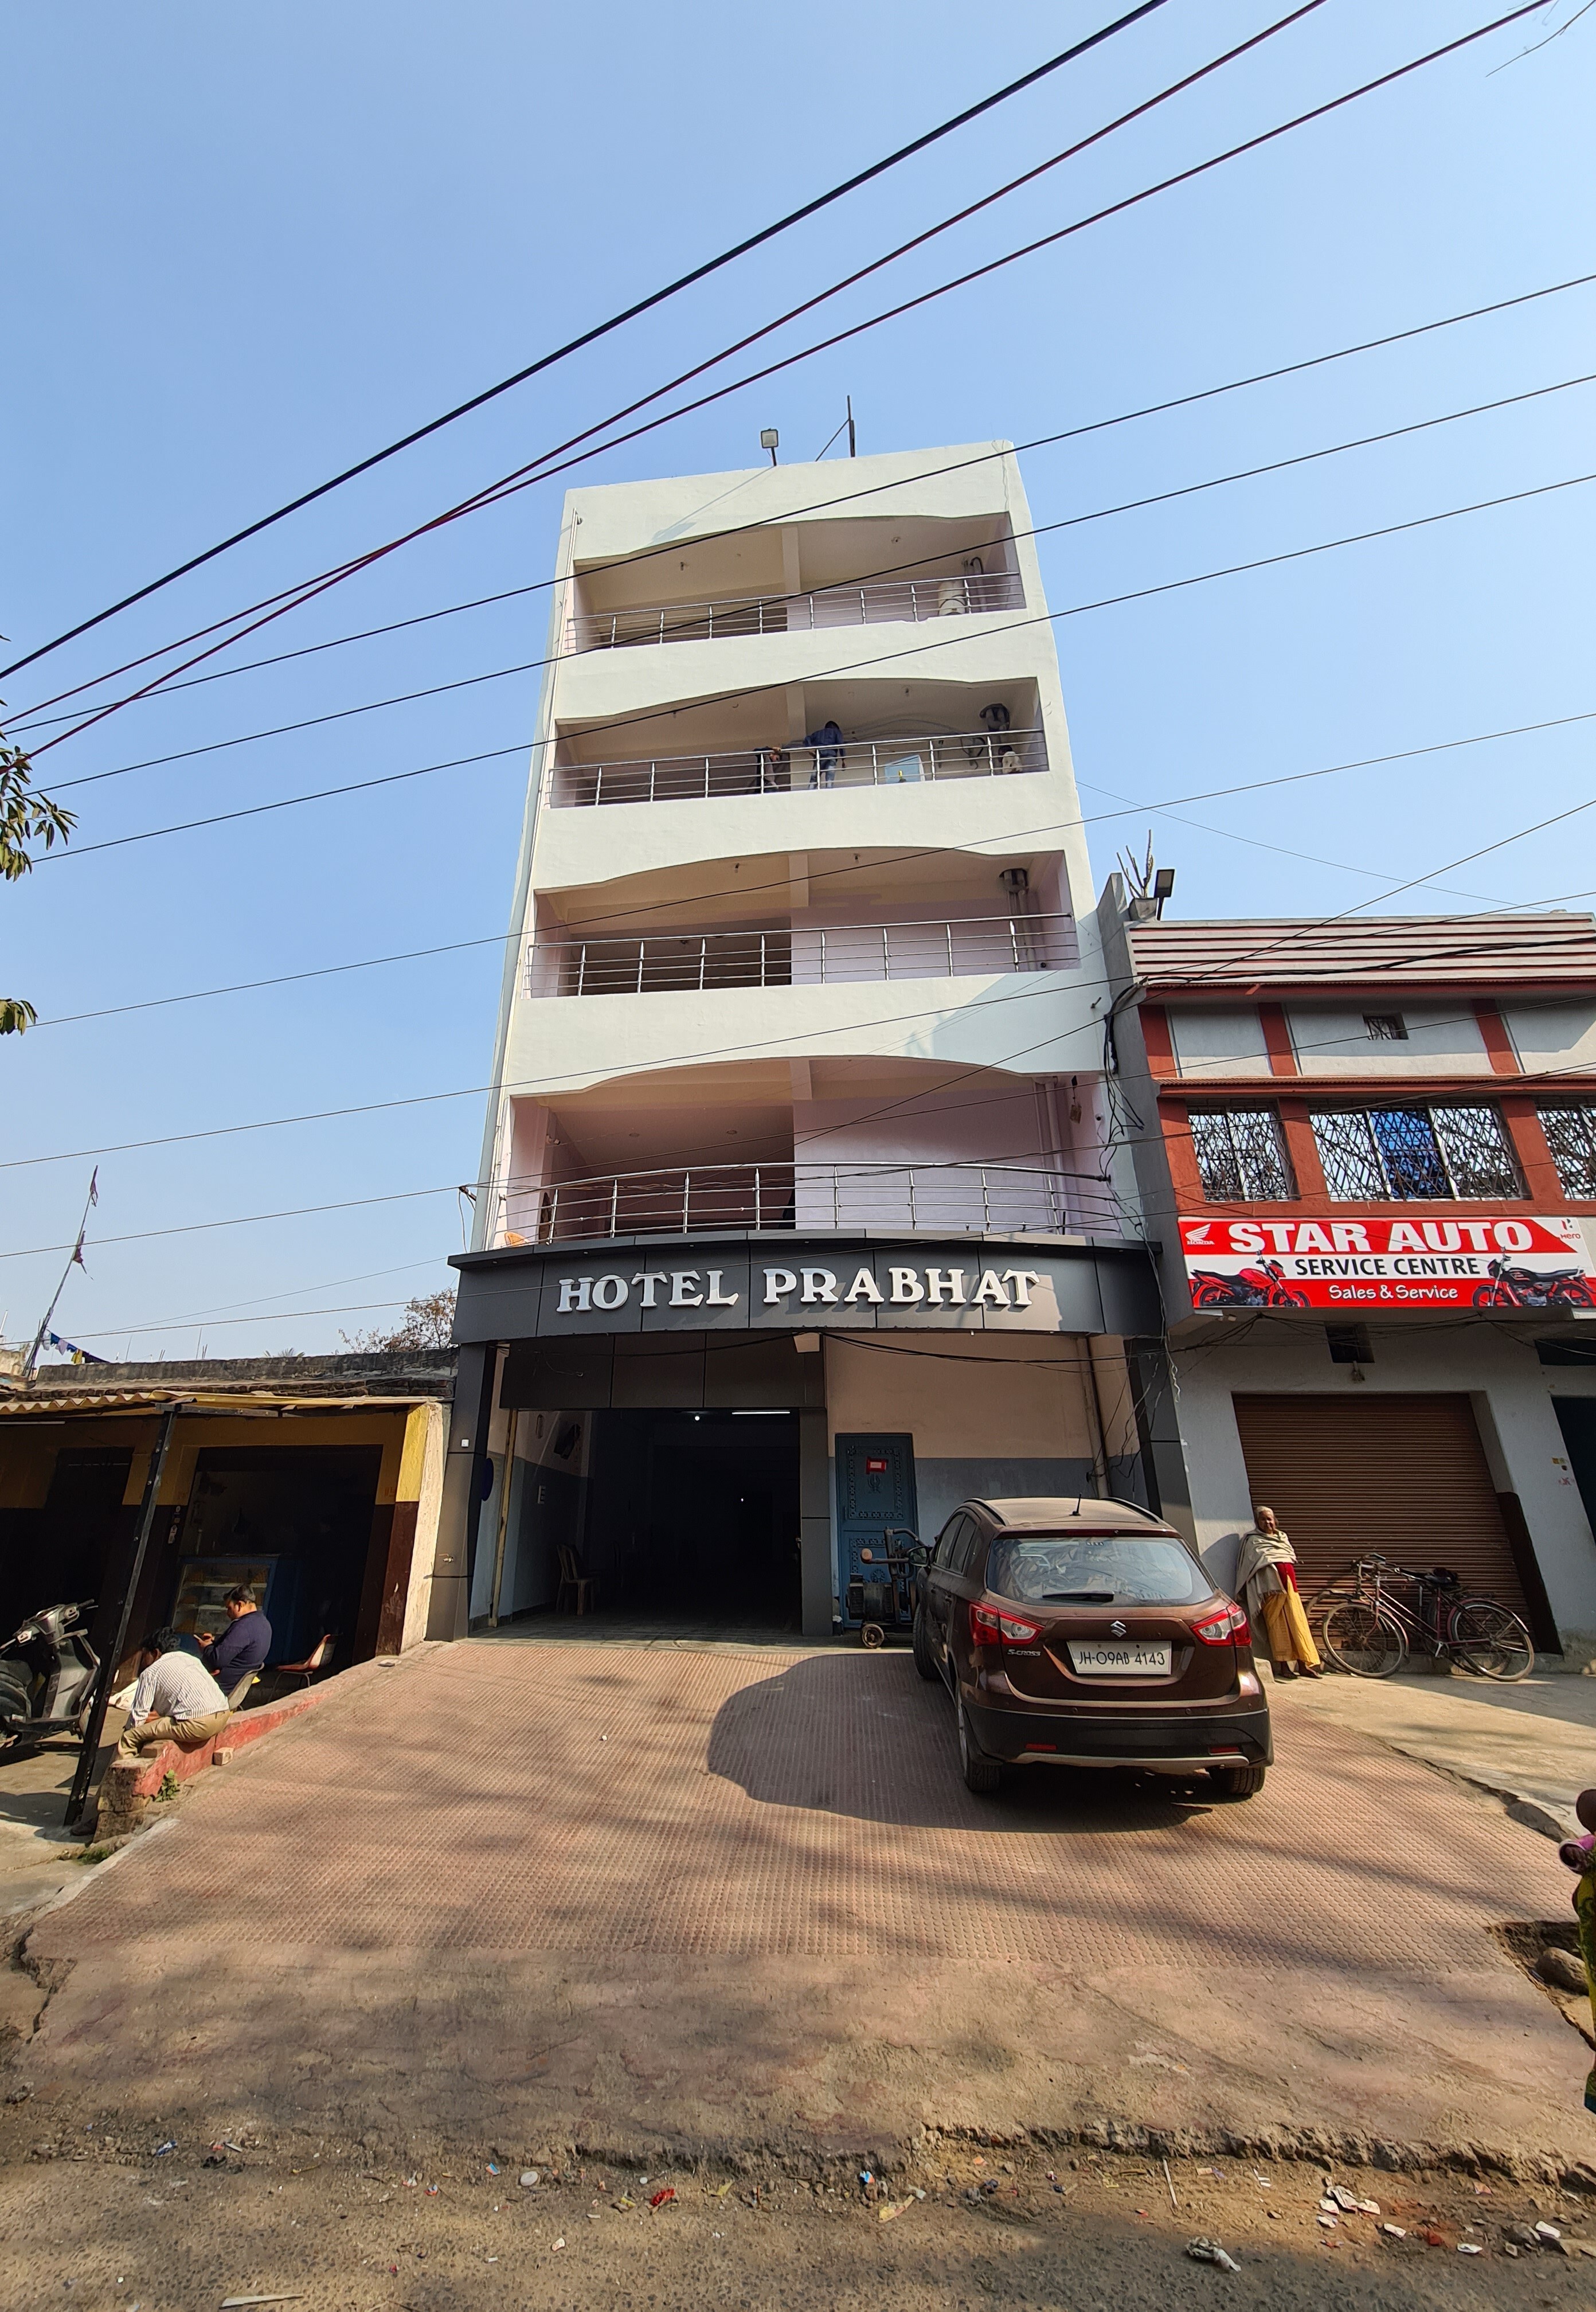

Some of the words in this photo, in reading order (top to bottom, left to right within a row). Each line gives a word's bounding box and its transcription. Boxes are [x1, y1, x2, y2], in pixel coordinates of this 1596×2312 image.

[1229, 1223, 1373, 1252] STAR
[1388, 1221, 1533, 1252] AUTO
[1294, 1259, 1387, 1275] SERVICE
[1394, 1257, 1481, 1275] CENTRE
[556, 1270, 739, 1313] HOTEL
[762, 1267, 1040, 1306] PRABHAT
[1328, 1284, 1376, 1300] Sales
[1379, 1284, 1394, 1299] &
[1395, 1284, 1459, 1300] Service
[1135, 1651, 1165, 1665] 4143
